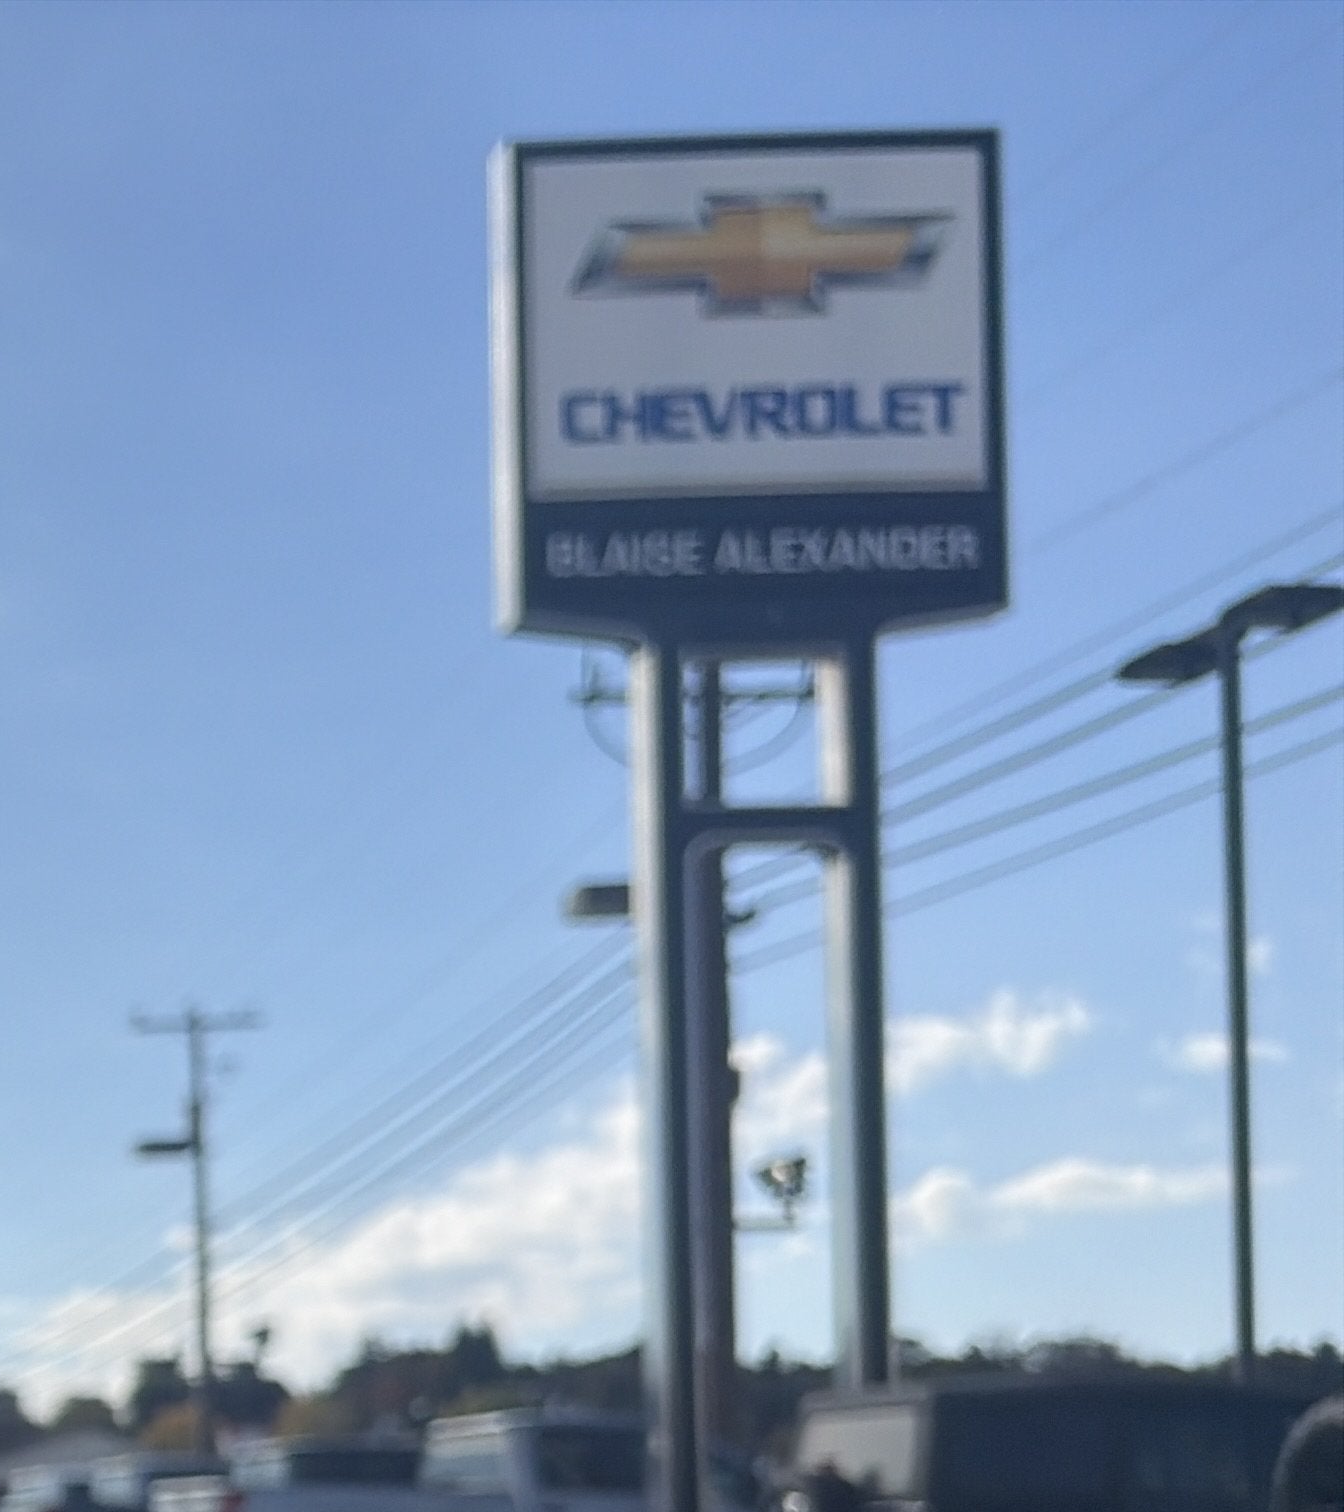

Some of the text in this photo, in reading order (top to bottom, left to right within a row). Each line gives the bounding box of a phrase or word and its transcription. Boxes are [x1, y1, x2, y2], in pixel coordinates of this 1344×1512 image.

[560, 381, 964, 443] CHEVROLET
[544, 524, 982, 577] BLAISE ALEXANDER
